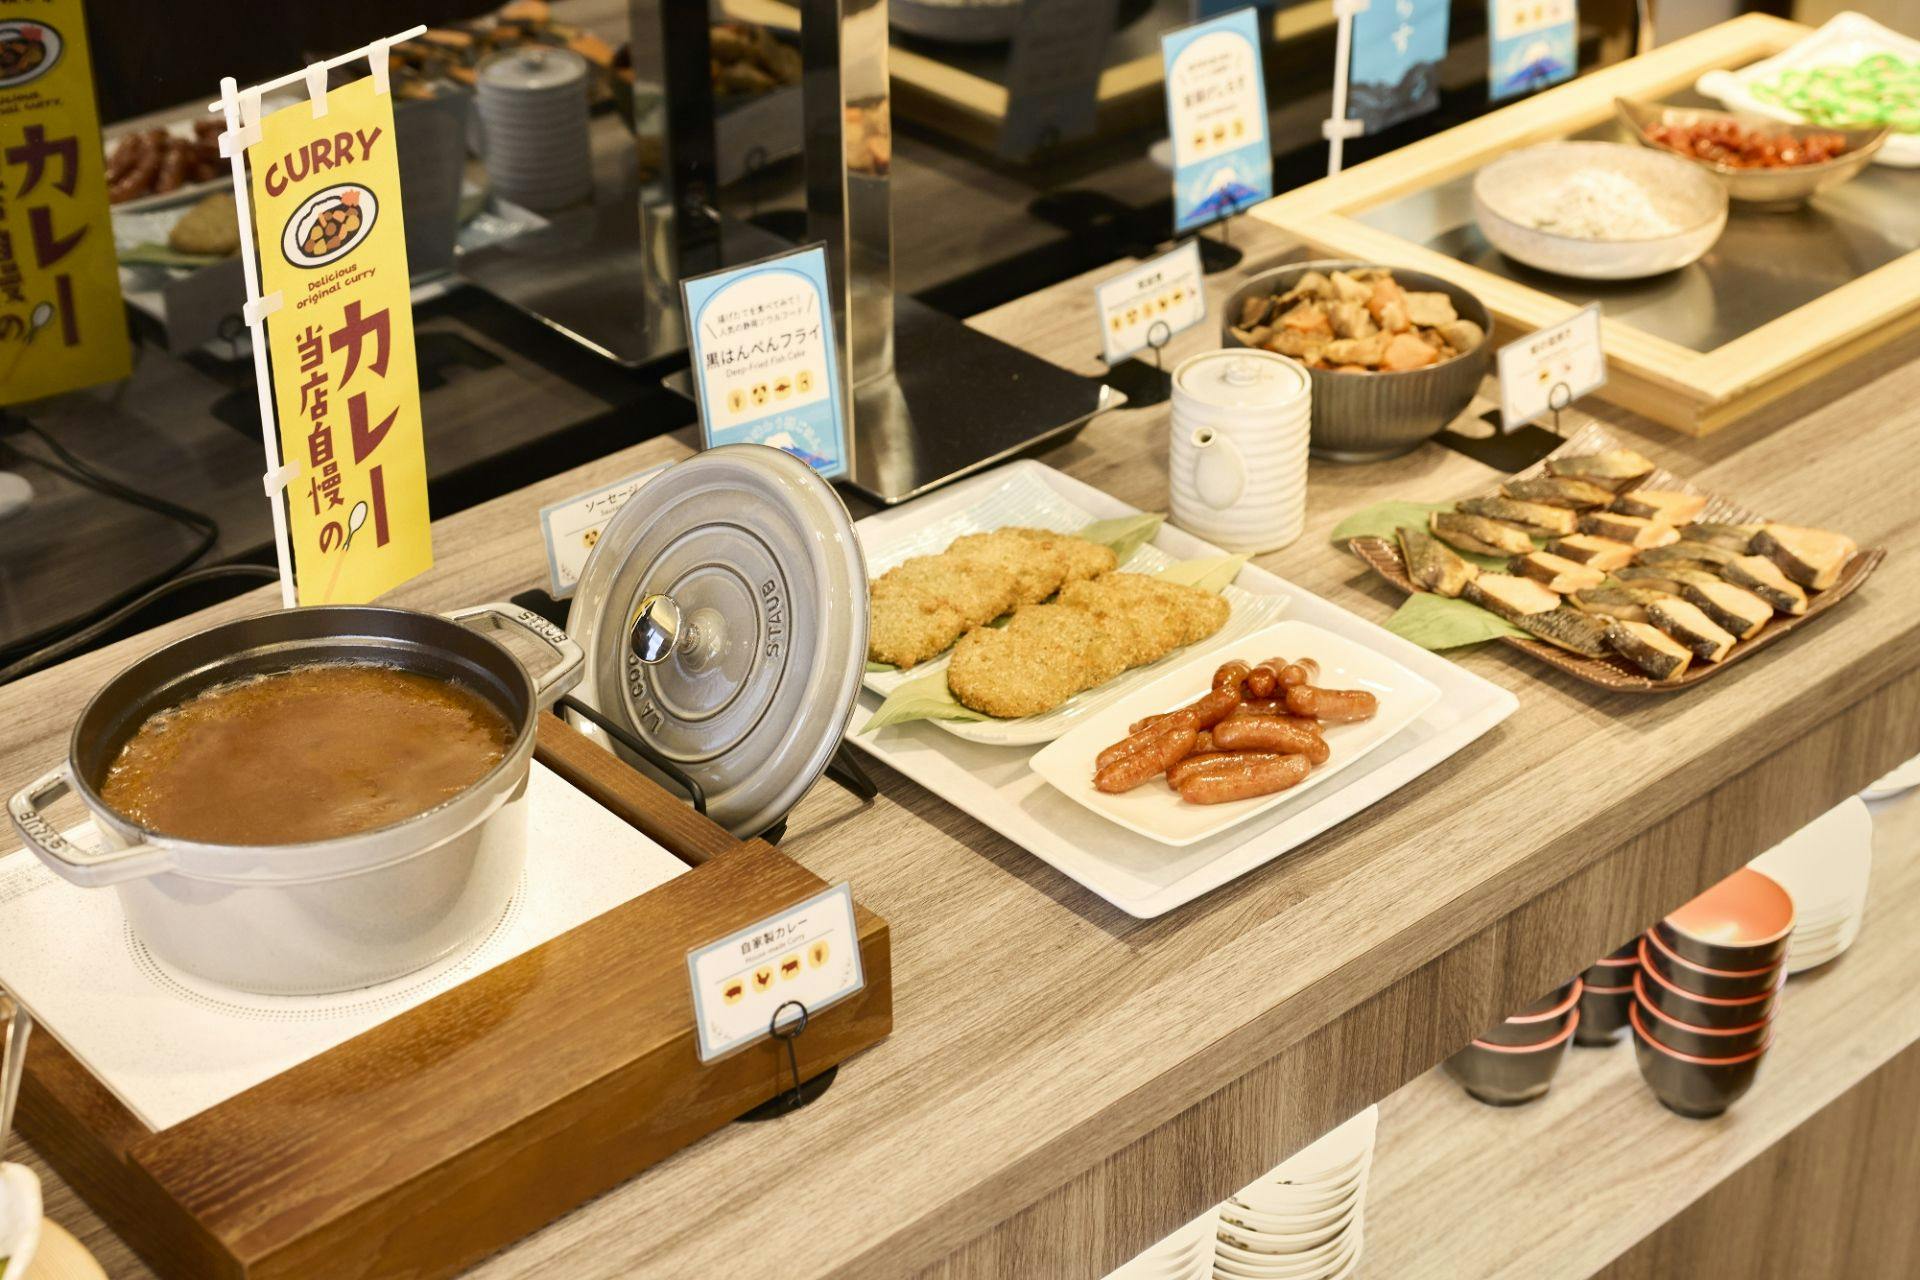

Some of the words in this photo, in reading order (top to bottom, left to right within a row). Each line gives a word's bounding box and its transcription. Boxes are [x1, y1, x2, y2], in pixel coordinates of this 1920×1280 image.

[265, 126, 383, 197] CURRY
[6, 123, 90, 347] カレー
[296, 278, 342, 309] original
[344, 267, 377, 286] curry
[307, 263, 358, 292] Delicious
[770, 354, 786, 365] Fish
[295, 323, 345, 554] 当店自慢の
[328, 299, 401, 549] カレー
[761, 579, 782, 657] STAUB
[741, 918, 808, 956] 自家製カレー
